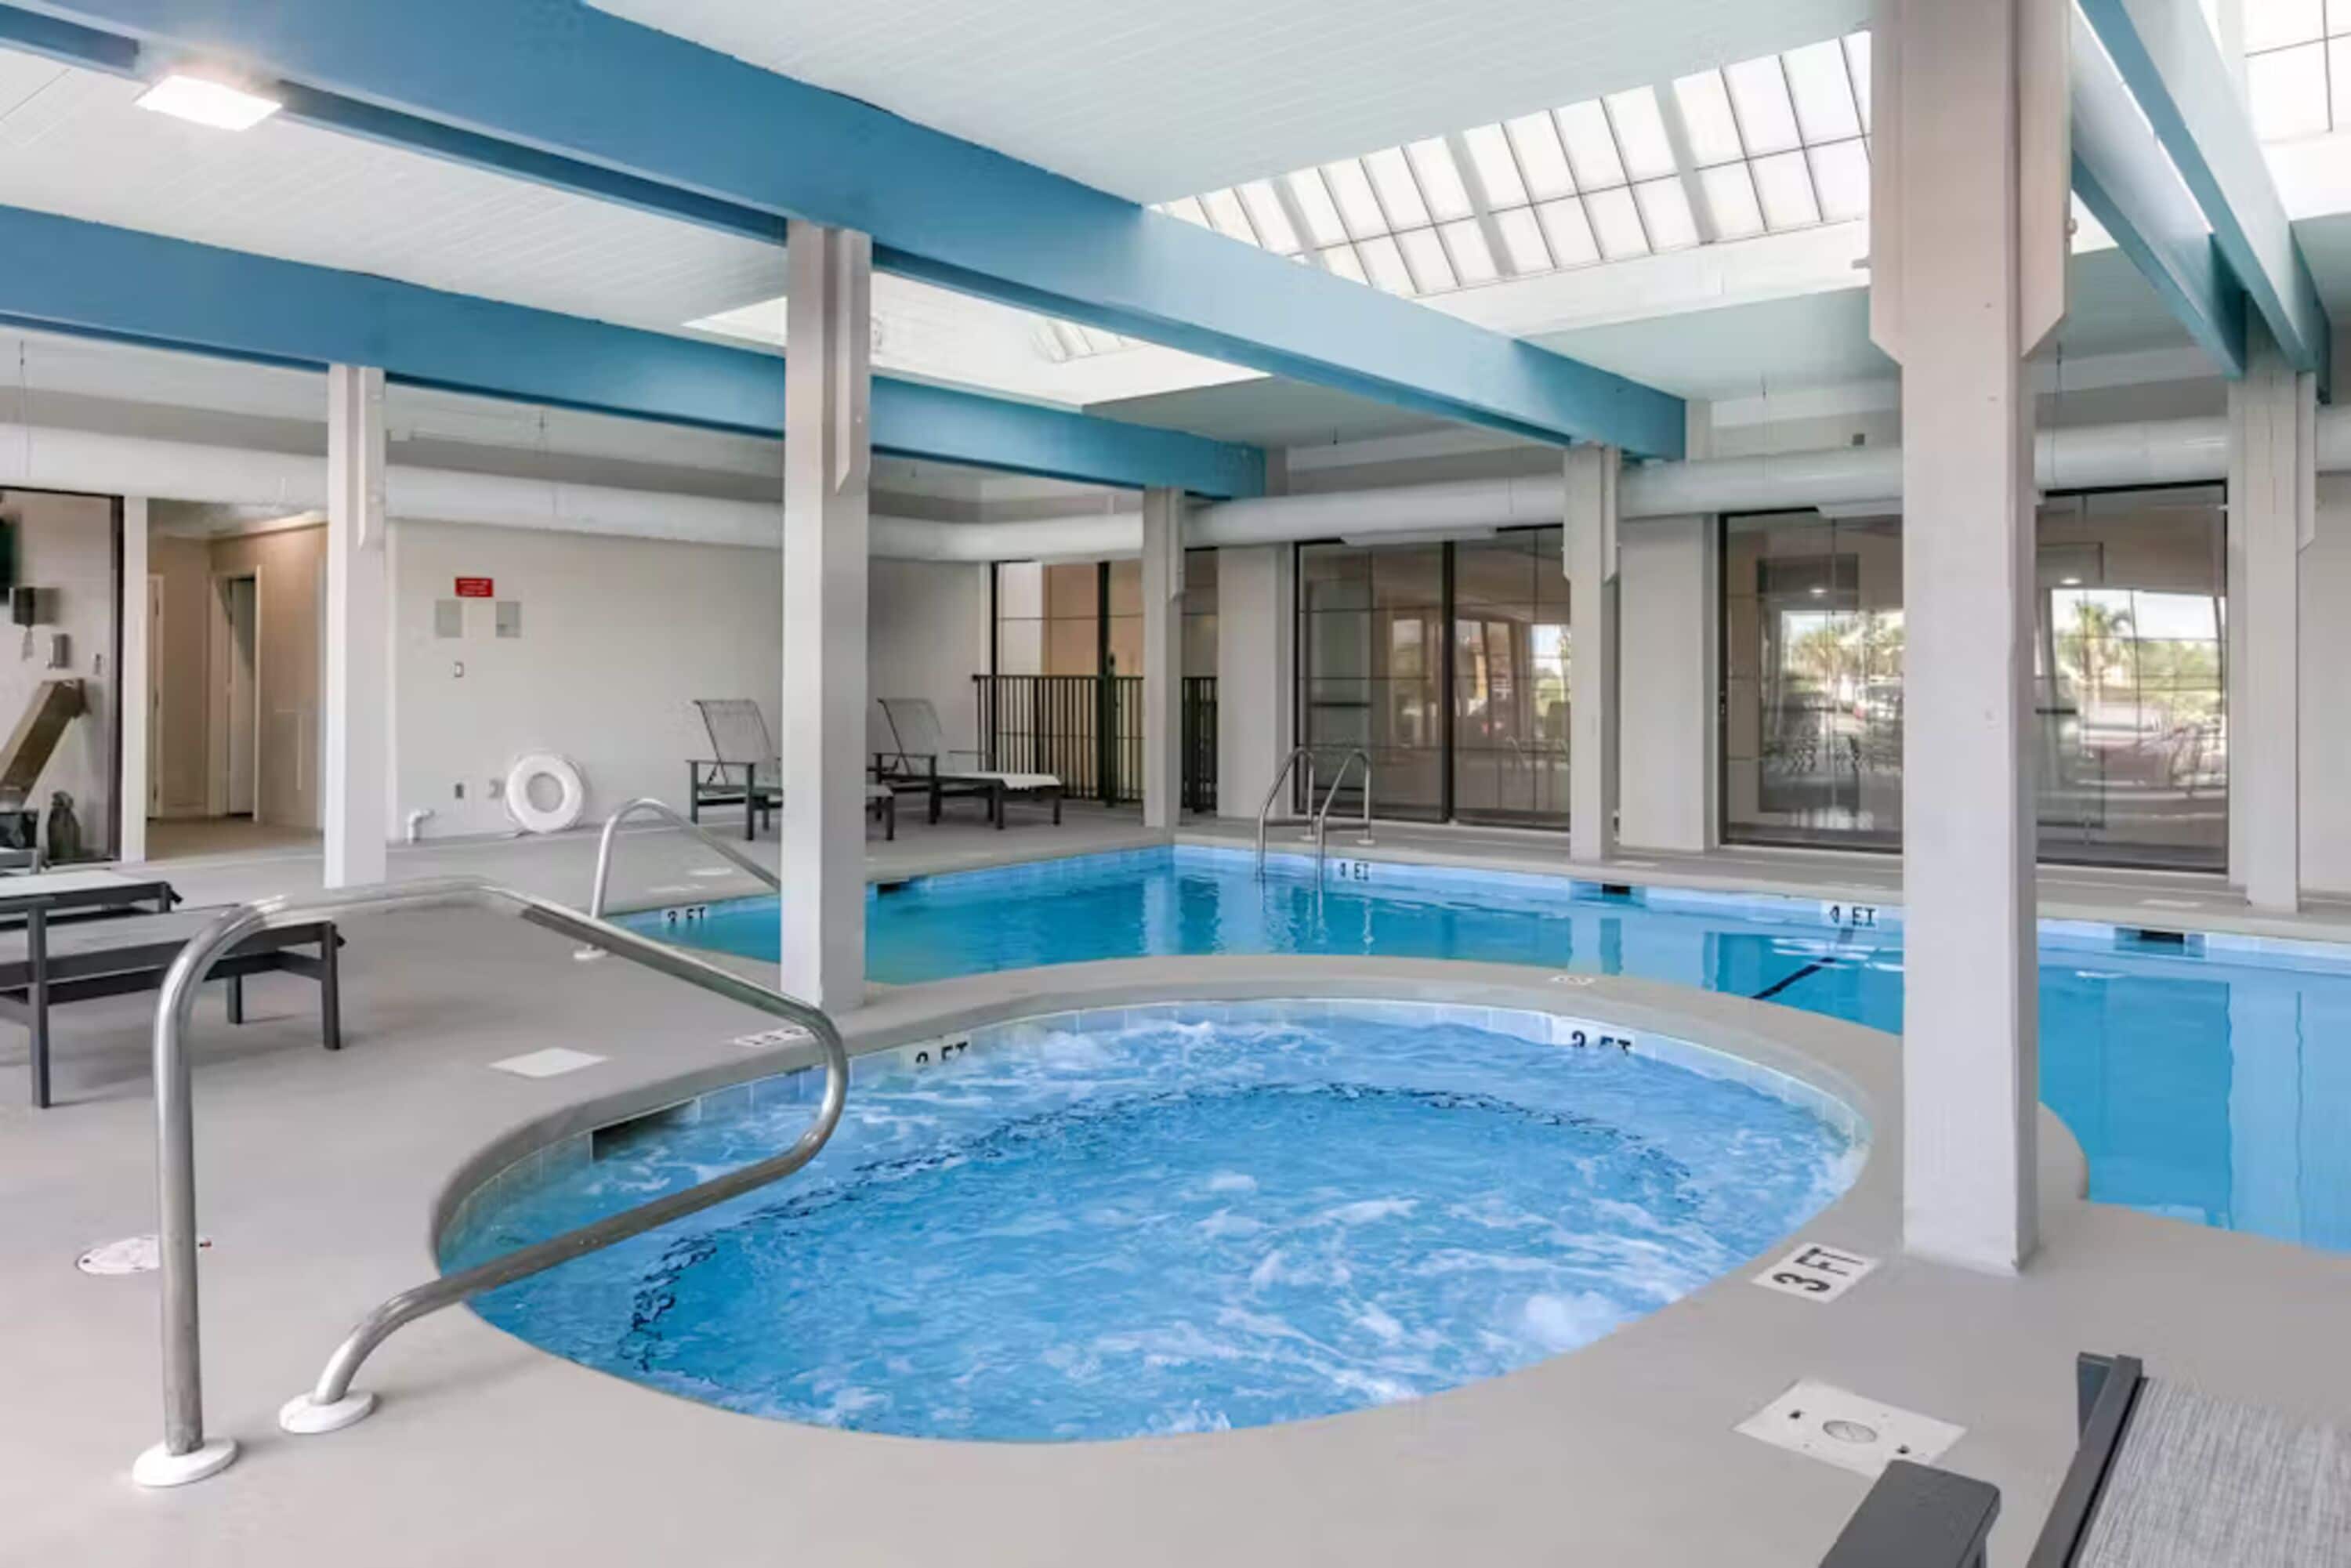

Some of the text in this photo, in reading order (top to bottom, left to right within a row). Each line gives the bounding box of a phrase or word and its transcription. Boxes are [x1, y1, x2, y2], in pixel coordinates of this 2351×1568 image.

[686, 906, 706, 920] FT
[1852, 907, 1876, 922] FT
[1772, 1247, 1865, 1292] 3 FT
